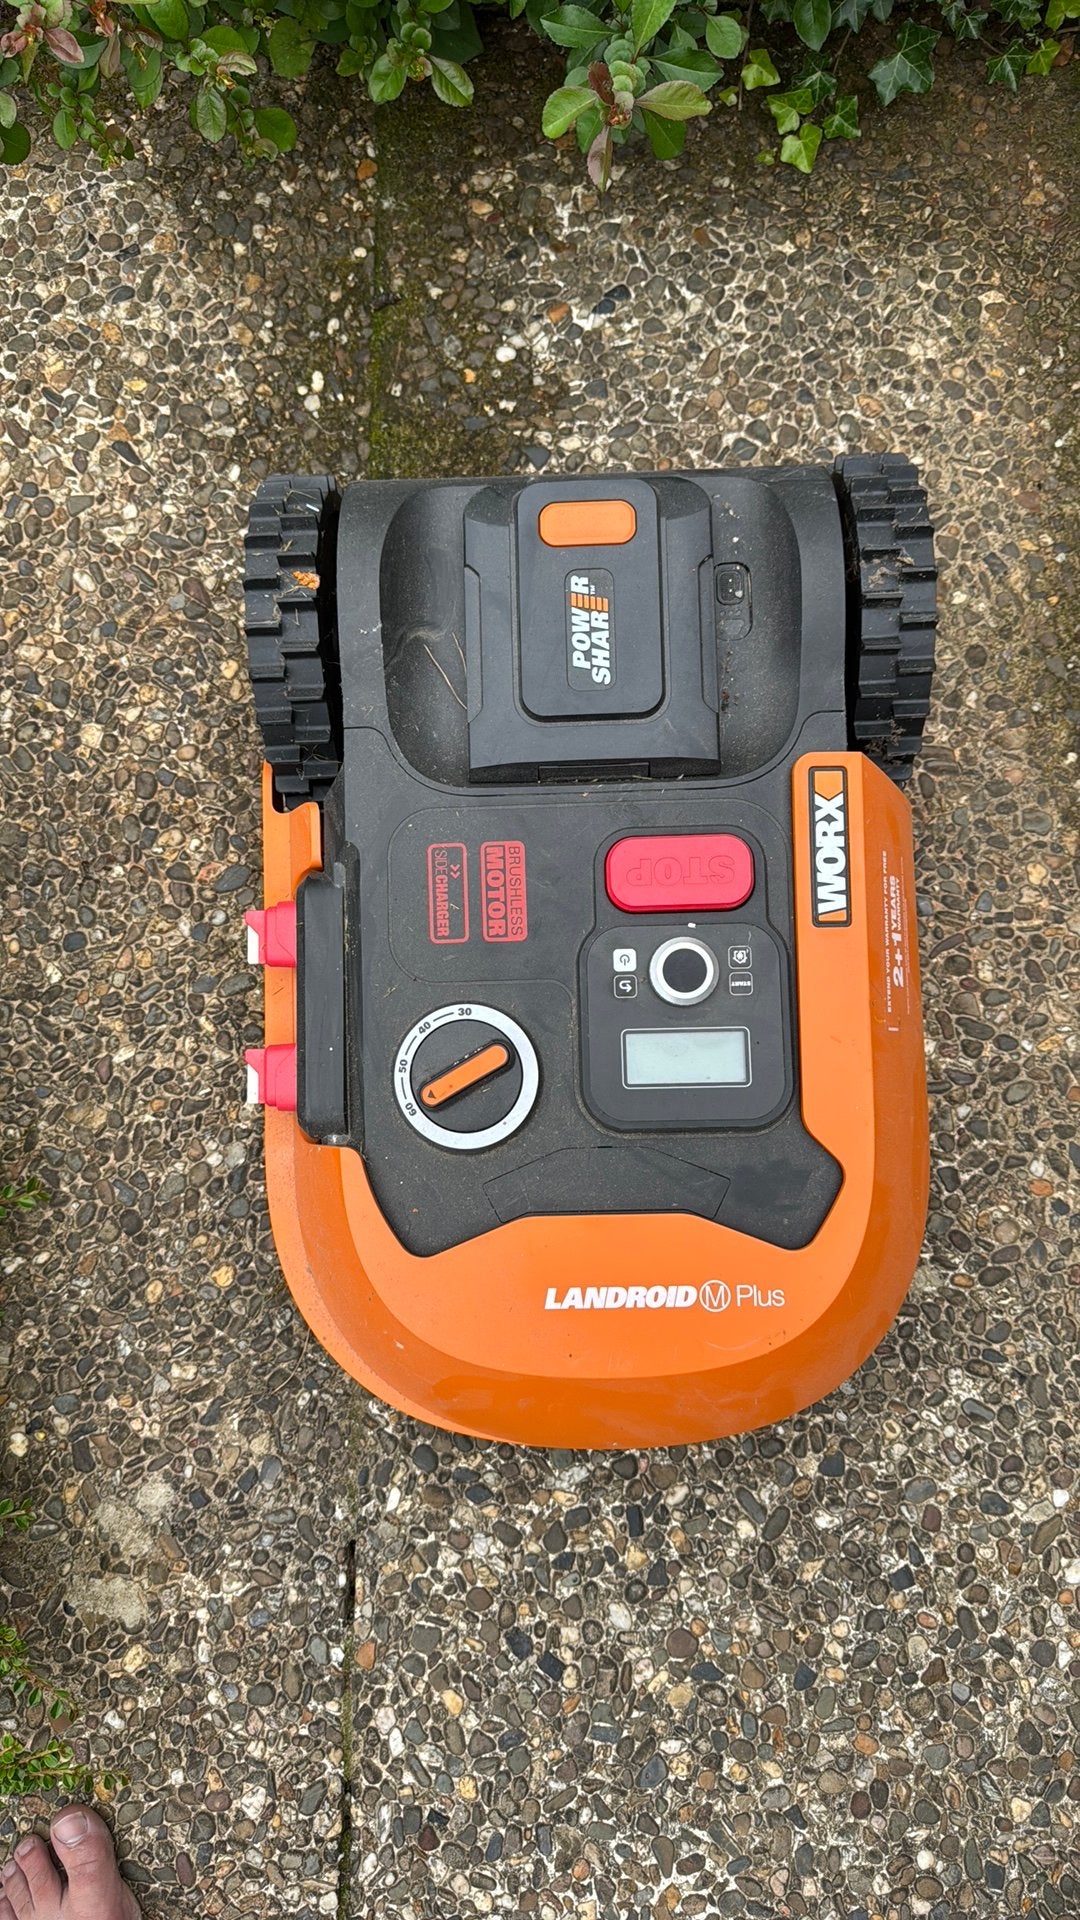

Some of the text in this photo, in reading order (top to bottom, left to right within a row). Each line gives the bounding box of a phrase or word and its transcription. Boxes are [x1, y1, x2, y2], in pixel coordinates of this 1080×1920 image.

[570, 575, 591, 670] POWER
[590, 597, 611, 685] SHARE
[625, 855, 736, 887] STOP
[814, 792, 847, 915] WORX
[485, 846, 506, 937] MOTOR
[508, 846, 524, 936] BRUSHLESS
[889, 875, 898, 931] YEARS
[418, 1021, 432, 1035] 40
[457, 1007, 472, 1016] 30
[398, 1059, 408, 1074] 50
[404, 1102, 417, 1117] 60
[544, 1285, 698, 1310] LANDROID
[736, 1284, 786, 1308] Plus
